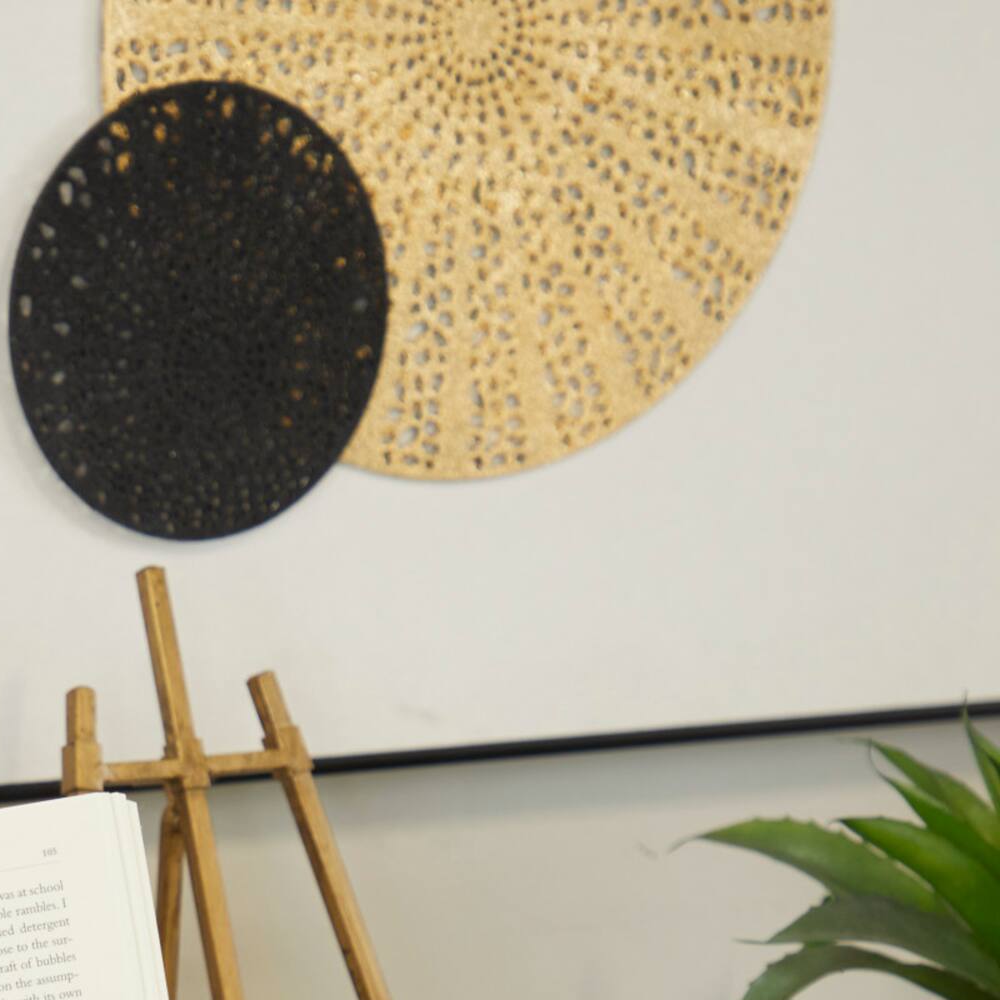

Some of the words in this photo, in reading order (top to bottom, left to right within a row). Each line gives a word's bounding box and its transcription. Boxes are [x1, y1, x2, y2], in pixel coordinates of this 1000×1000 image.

[29, 879, 63, 896] school
[19, 917, 69, 934] detergent
[35, 951, 77, 967] bubbles
